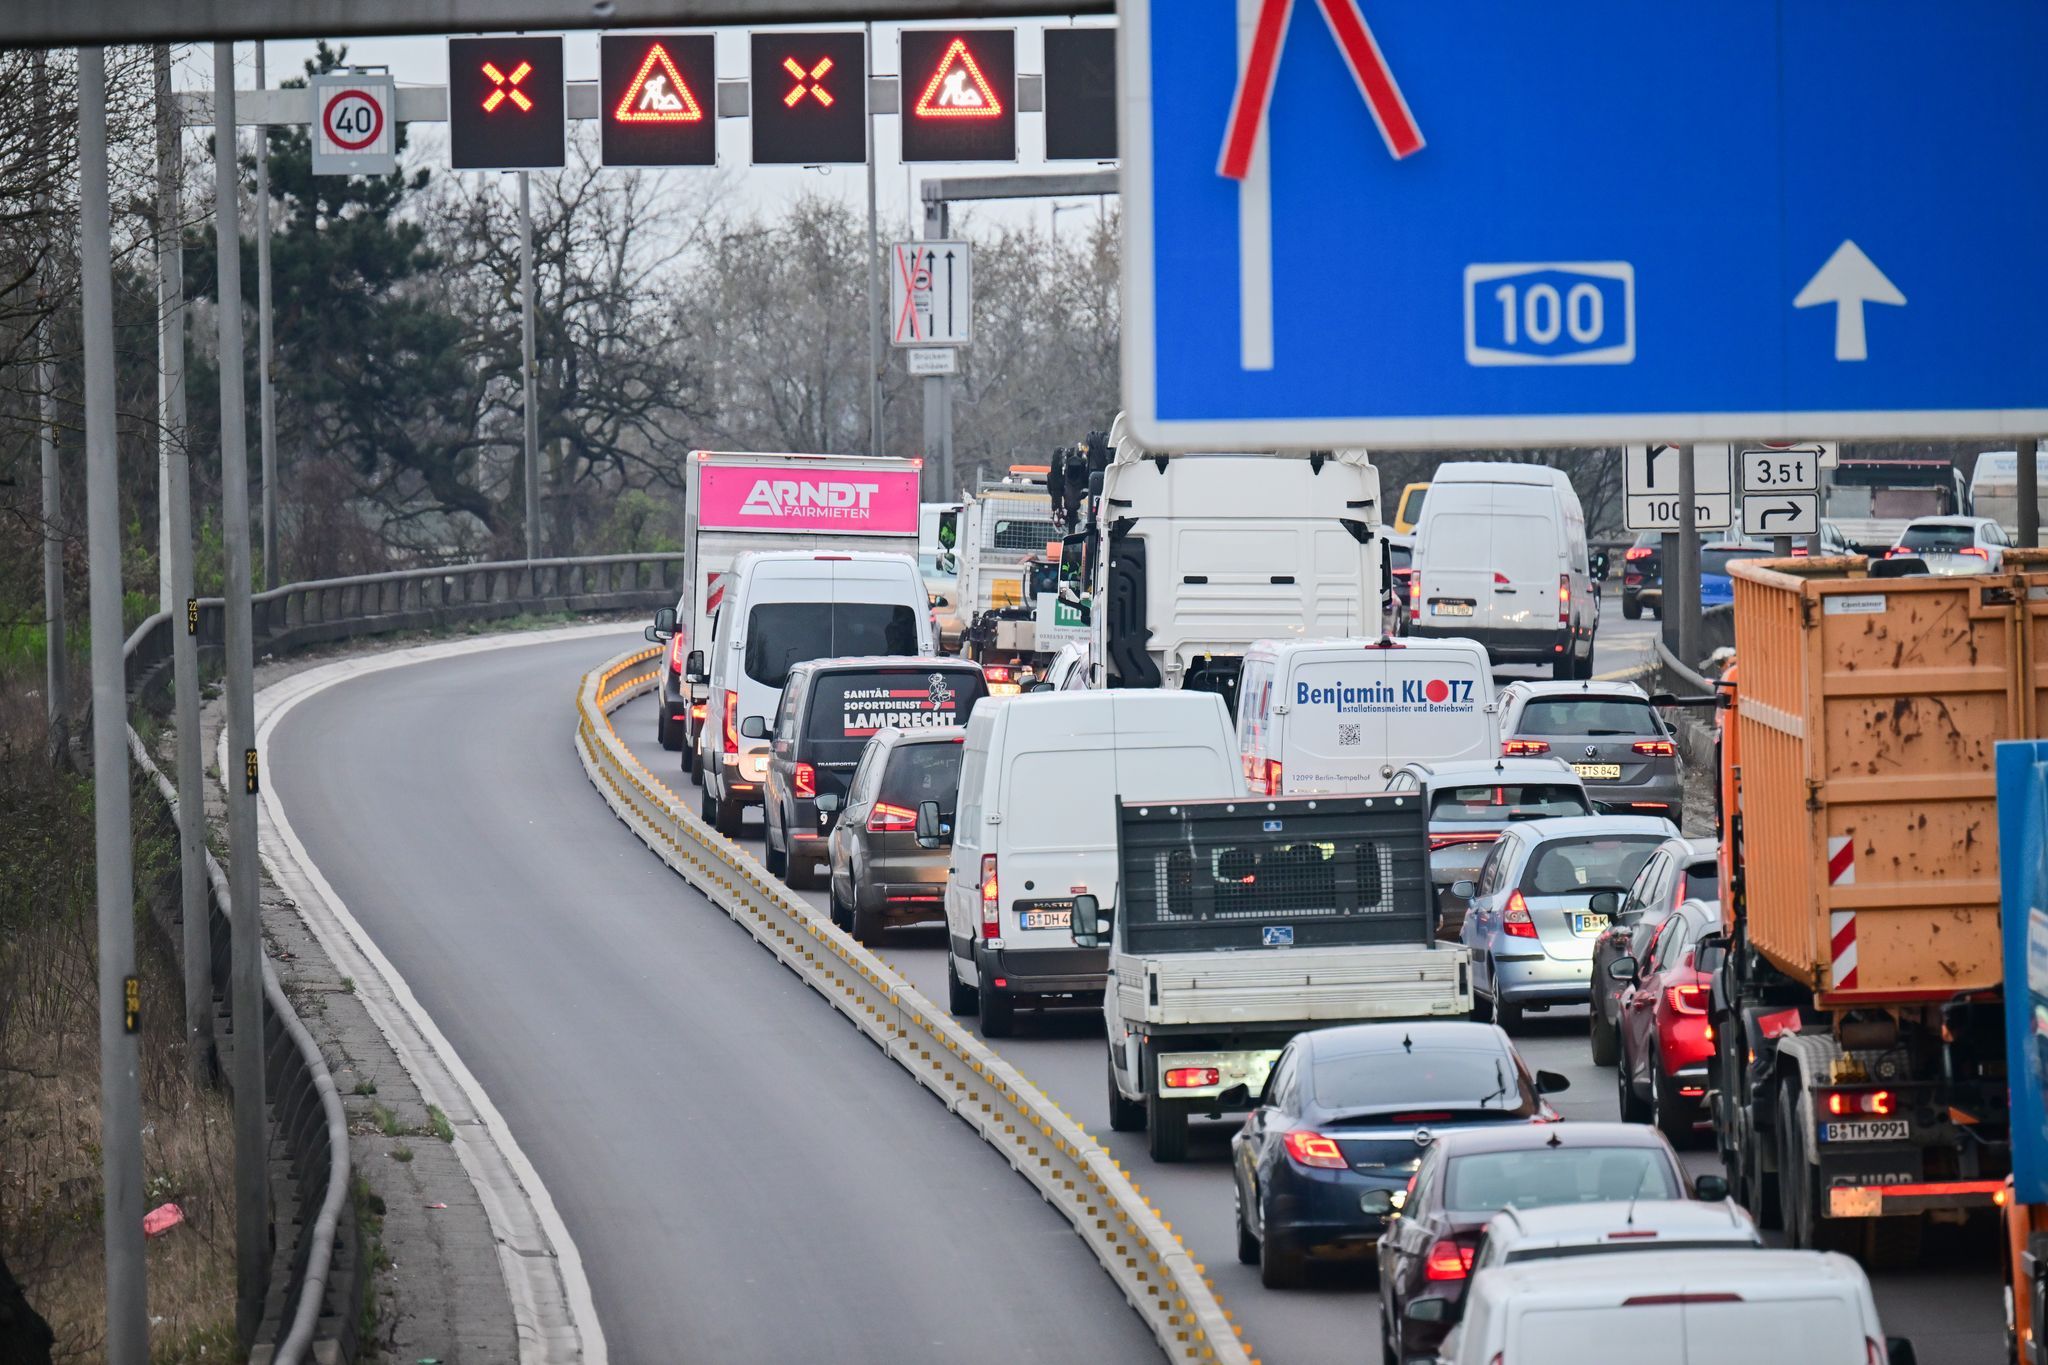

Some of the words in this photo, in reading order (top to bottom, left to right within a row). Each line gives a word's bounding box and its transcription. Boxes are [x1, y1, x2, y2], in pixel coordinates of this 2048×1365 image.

[336, 107, 371, 133] 40
[1496, 283, 1604, 345] 100
[1757, 460, 1791, 484] 3,5
[739, 480, 879, 516] ARNDT
[784, 506, 870, 519] FAIRMIETEN
[1648, 502, 1680, 522] 100
[1695, 506, 1710, 521] m
[844, 688, 890, 699] SANITÄR
[1297, 681, 1394, 712] Benjamin
[1403, 680, 1474, 703] KLOTZ
[844, 701, 921, 711] SOFORTDIENST
[1414, 704, 1427, 712] und
[1430, 704, 1474, 713] Betriebswirt
[844, 712, 956, 729] LAMPRECHT
[247, 752, 257, 764] 22
[1588, 766, 1599, 776] TS
[1600, 766, 1618, 776] 842
[1315, 773, 1371, 783] Berlin-Tempelhof
[1028, 915, 1036, 926] B
[1044, 914, 1060, 926] DH
[1584, 917, 1591, 928] B
[1829, 1125, 1839, 1139] B
[1849, 1124, 1868, 1138] TM
[1870, 1122, 1907, 1138] 9991
